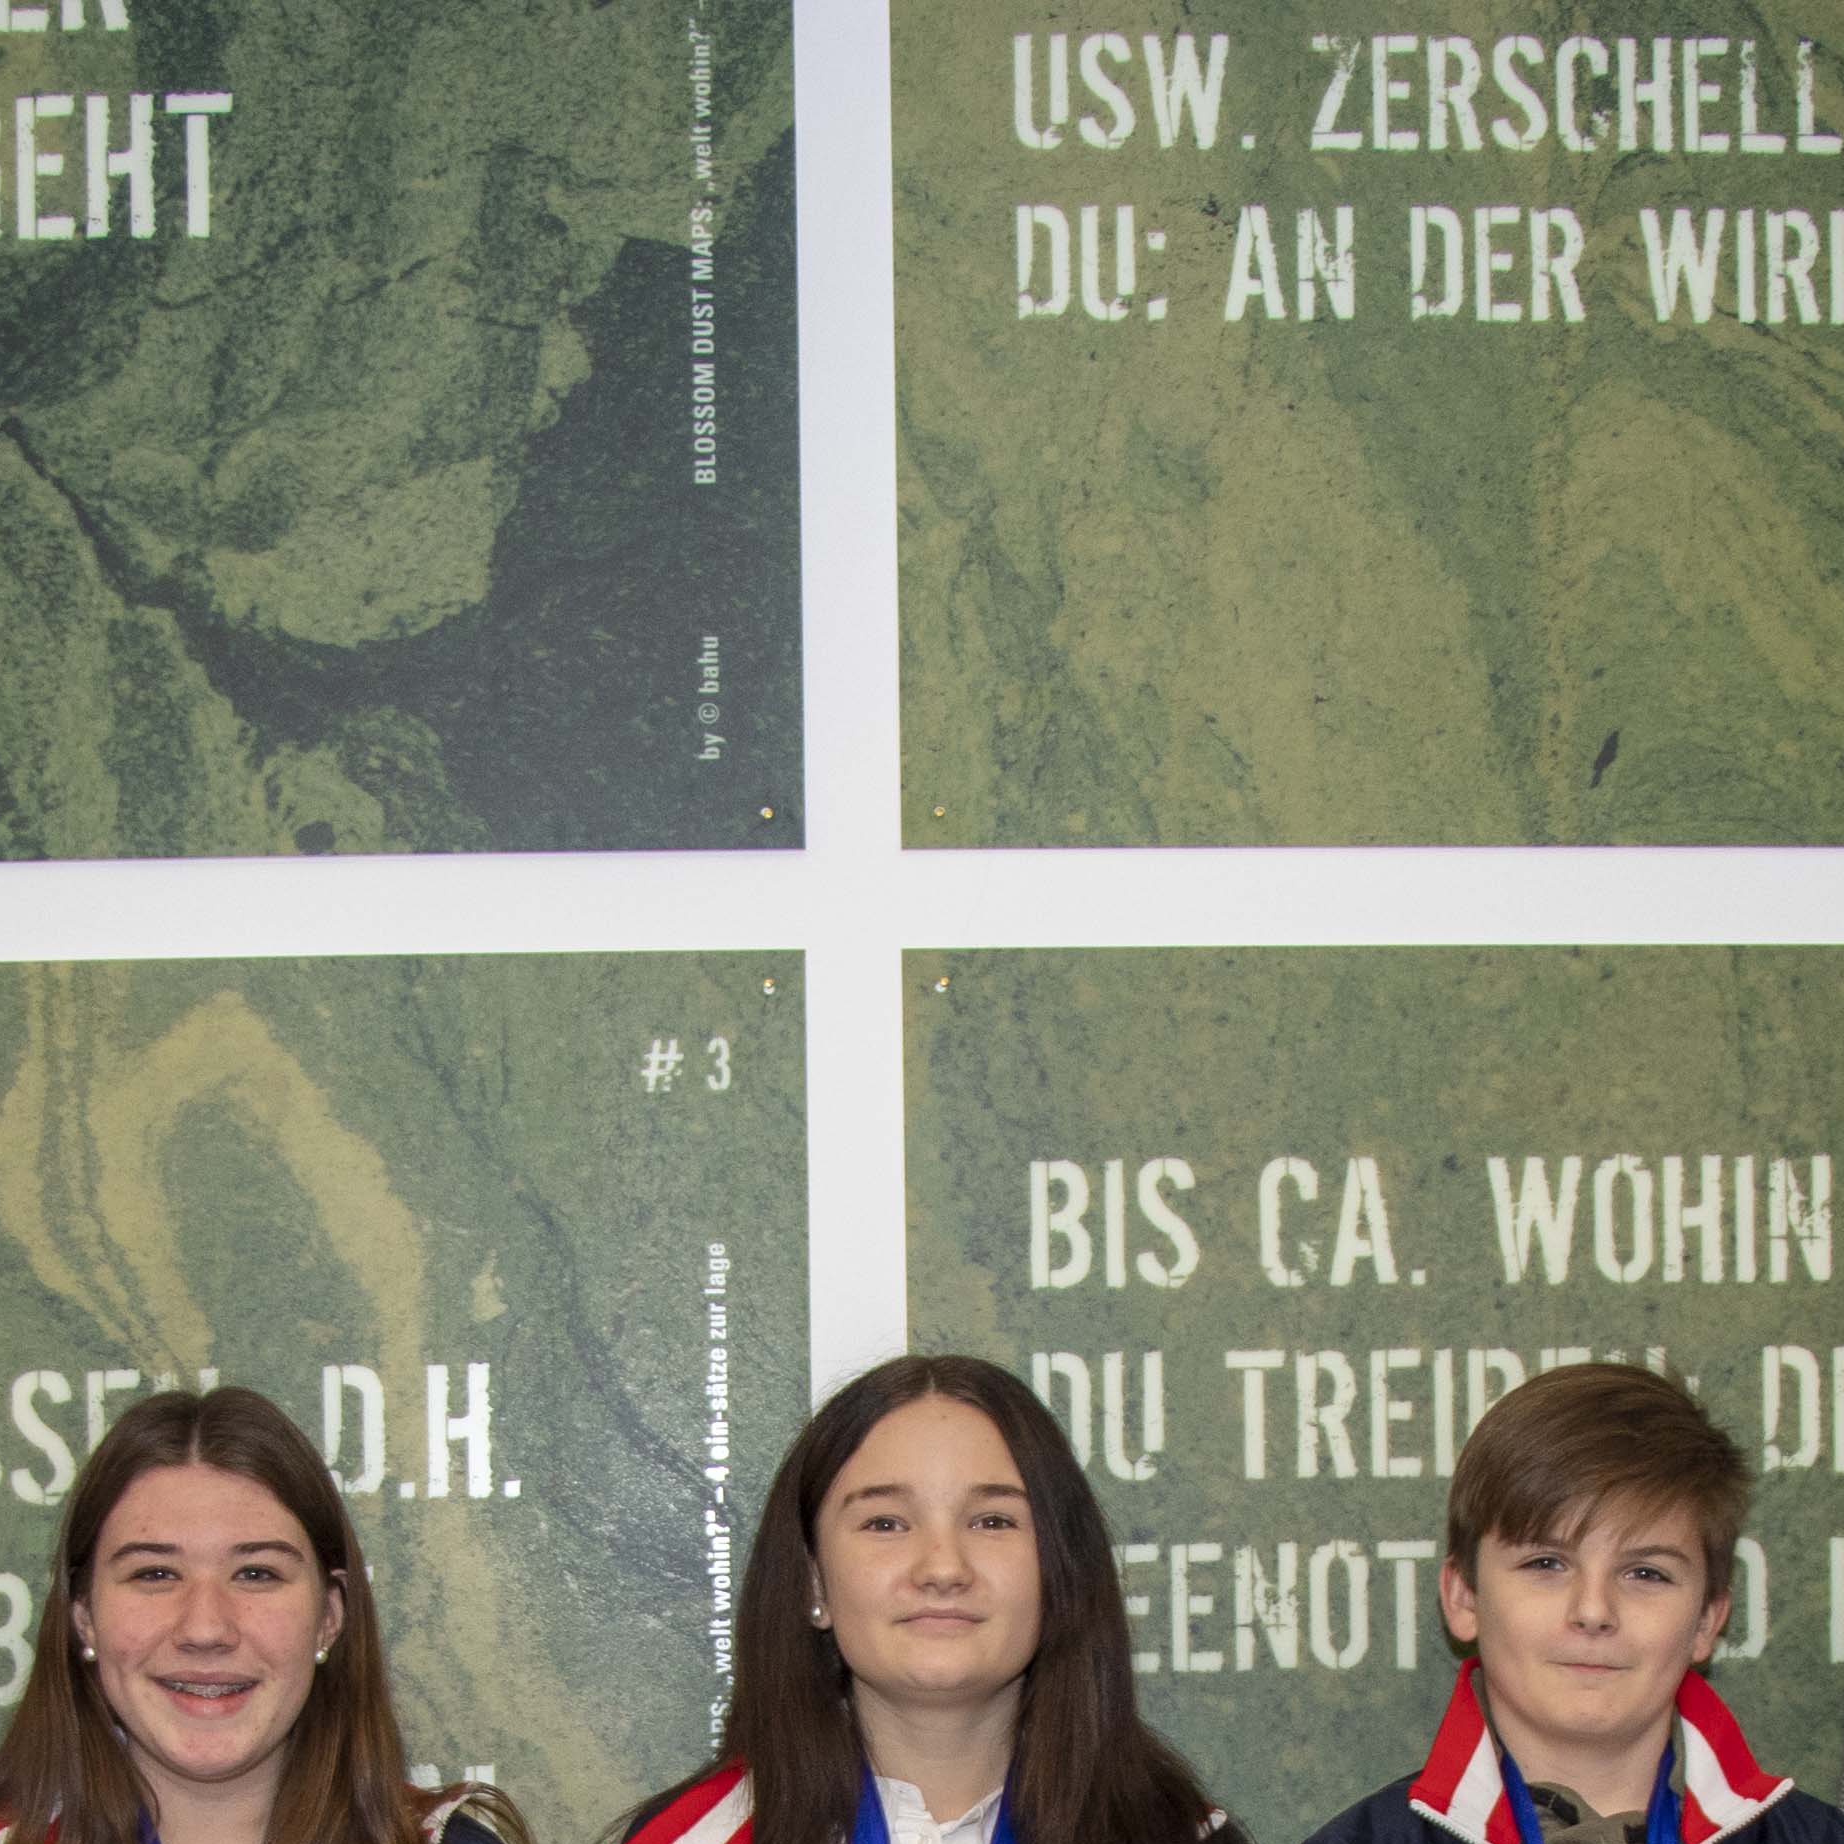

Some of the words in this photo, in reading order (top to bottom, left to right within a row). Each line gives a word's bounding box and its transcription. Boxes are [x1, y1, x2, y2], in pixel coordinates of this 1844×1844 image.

[1013, 33, 1256, 150] USW.
[691, 200, 714, 280] MAPS:
[1015, 204, 1168, 322] DU:
[1224, 205, 1356, 322] AN
[1410, 205, 1587, 323] DER
[692, 289, 715, 355] DUST
[693, 363, 717, 484] BLOSSOM
[697, 637, 720, 693] bahu
[698, 733, 726, 761] by
[707, 1036, 731, 1090] 3
[1028, 1155, 1203, 1291] BIS
[1257, 1155, 1427, 1289] CA.
[1487, 1153, 1833, 1286] WOHIN
[704, 1242, 730, 1295] lage
[709, 1302, 728, 1340] zur
[322, 1362, 522, 1499] D.H.
[1032, 1351, 1165, 1482] DU
